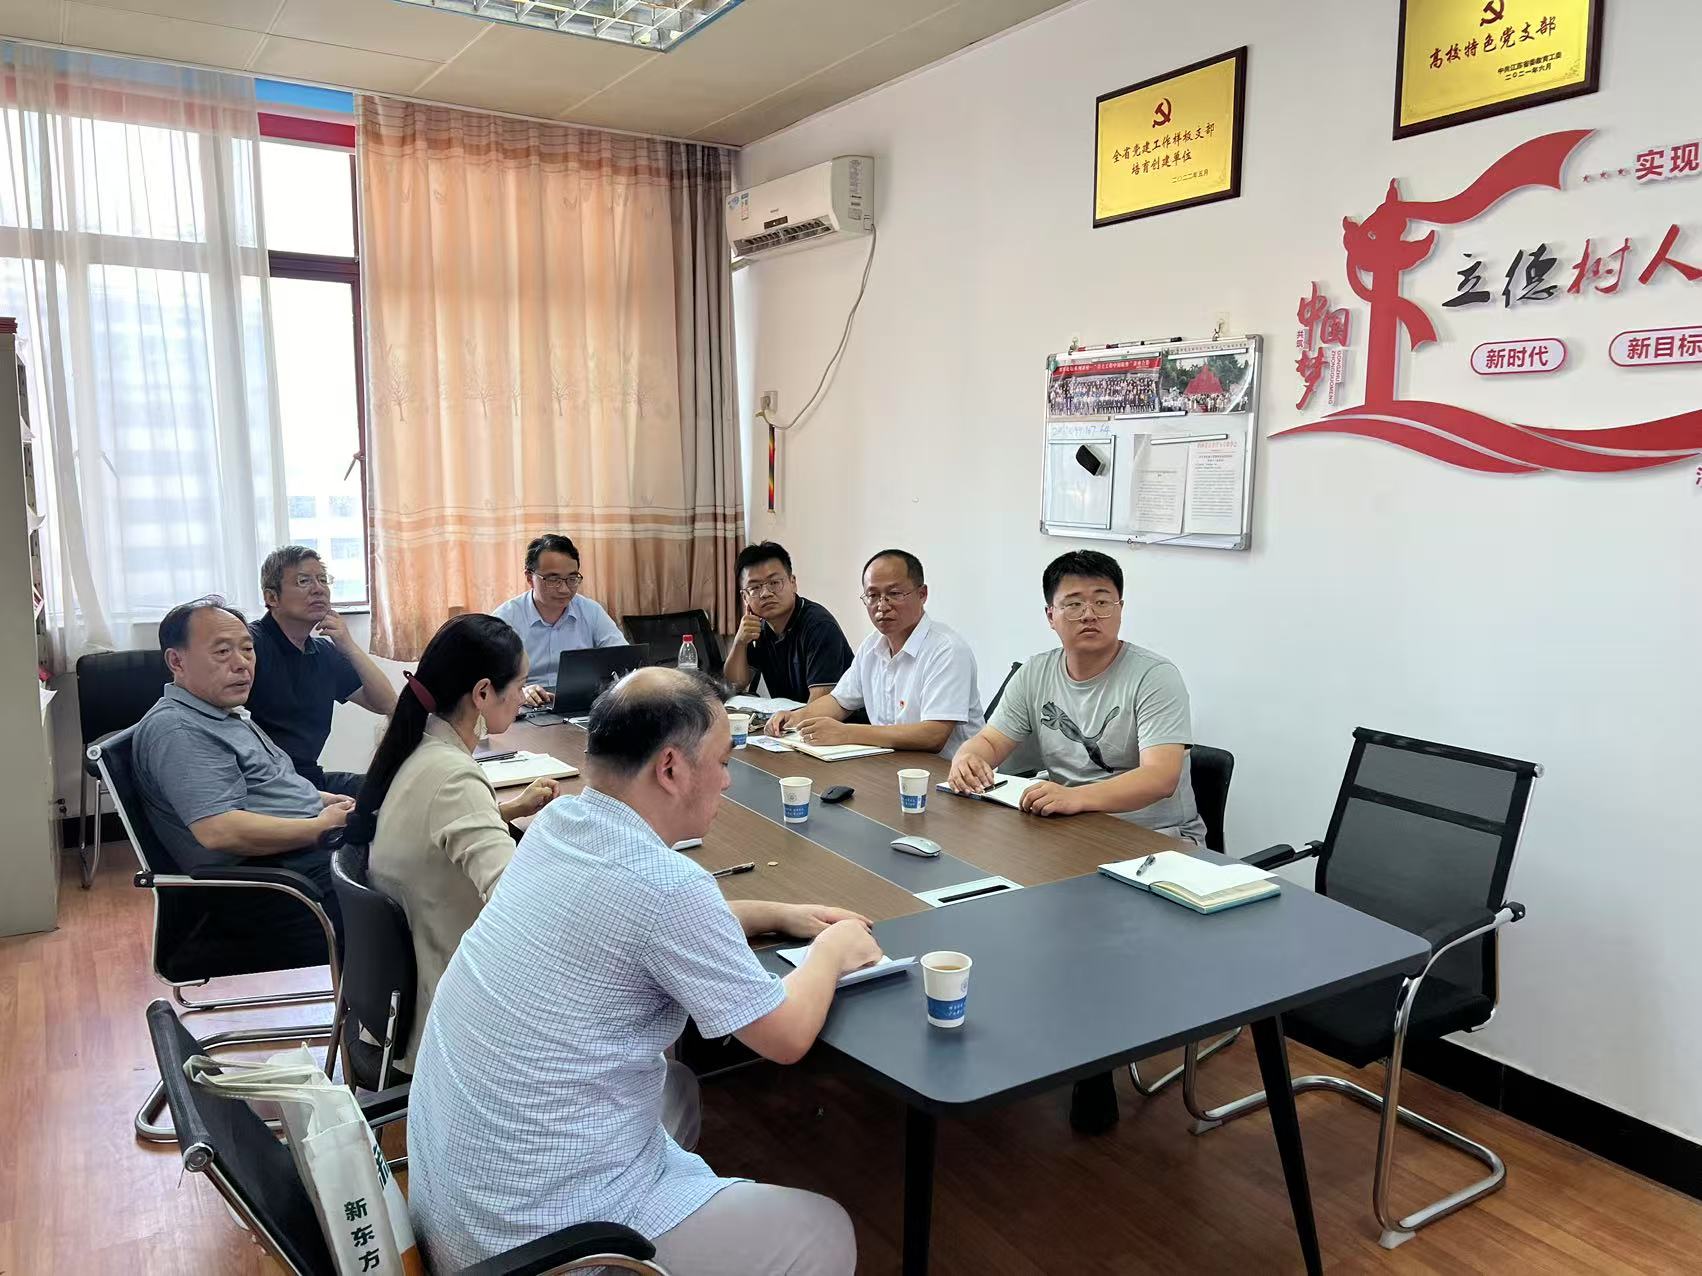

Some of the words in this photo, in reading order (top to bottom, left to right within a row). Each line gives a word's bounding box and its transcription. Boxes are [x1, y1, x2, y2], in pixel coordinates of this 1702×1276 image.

[1428, 16, 1557, 70] 高校特色党支部
[1112, 122, 1216, 164] 全省党建工作样板支部
[1131, 149, 1192, 175] 培育创建单位
[1634, 141, 1700, 180] 实现
[1441, 223, 1702, 309] 立德树人
[1485, 344, 1550, 370] 新时代
[1626, 333, 1702, 360] 新目标
[343, 1197, 381, 1273] 新东方
